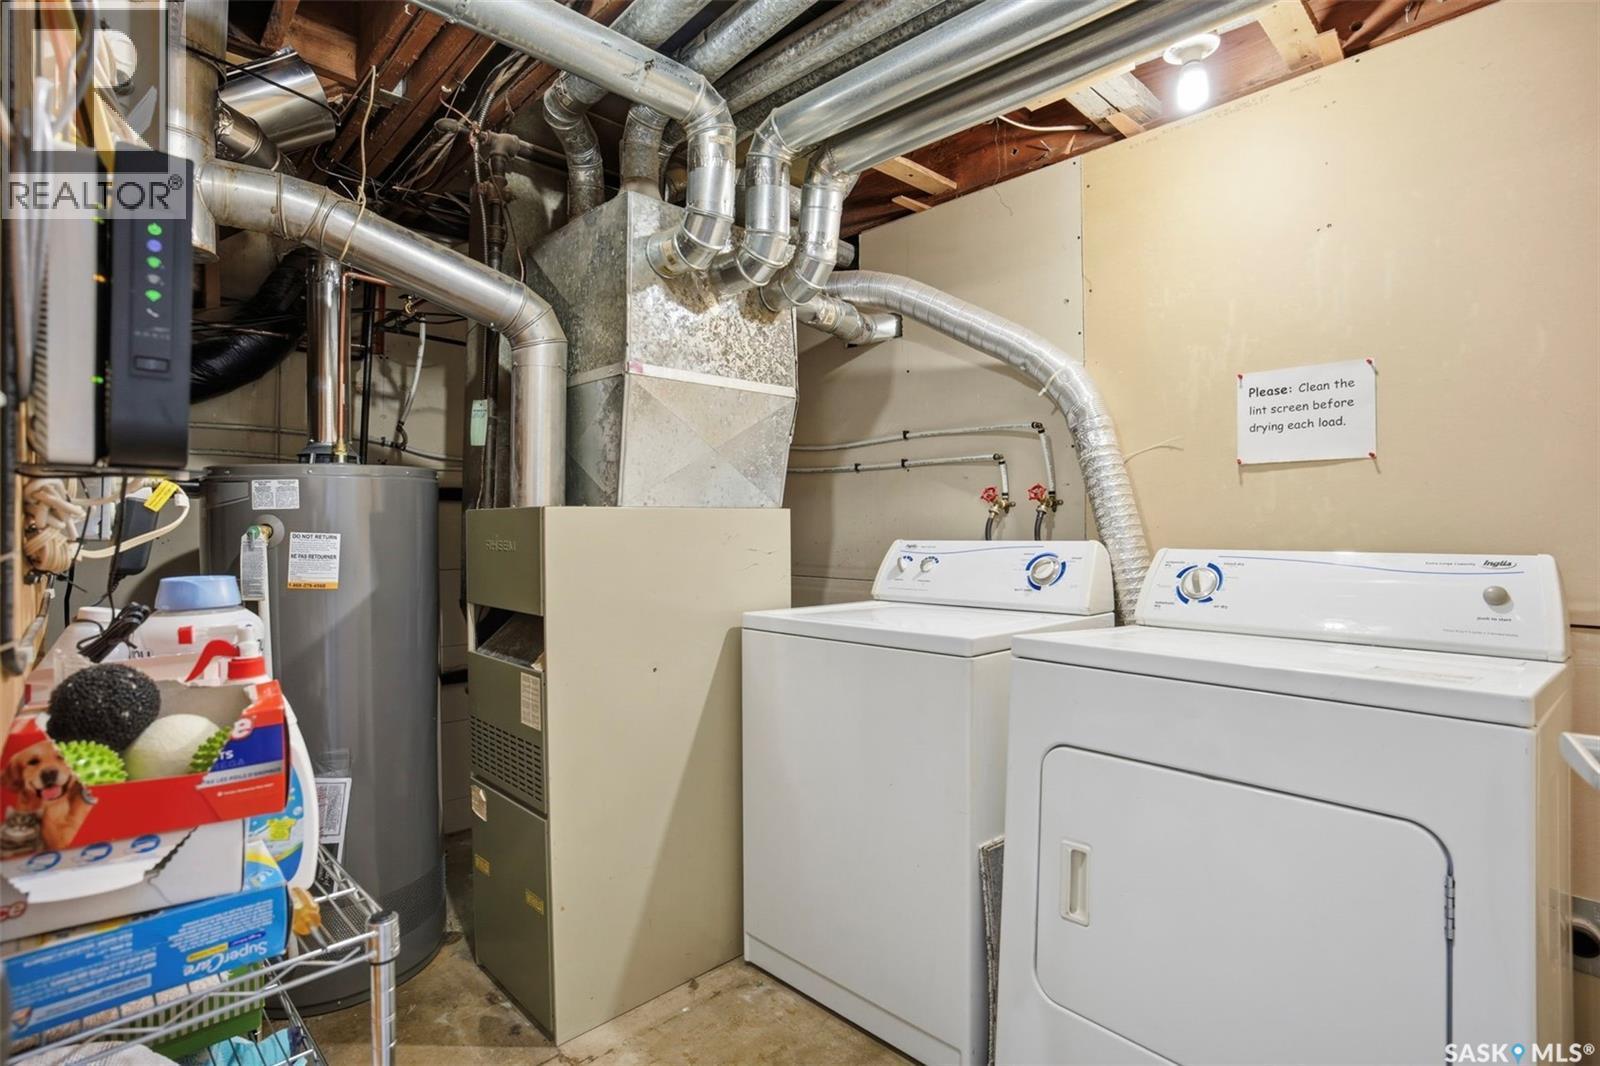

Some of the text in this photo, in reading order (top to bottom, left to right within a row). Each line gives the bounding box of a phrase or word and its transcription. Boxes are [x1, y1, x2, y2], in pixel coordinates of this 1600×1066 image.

[1248, 378, 1355, 398] Please: Clean the
[1249, 398, 1355, 416] lint screen before
[1249, 416, 1346, 435] drying each load.
